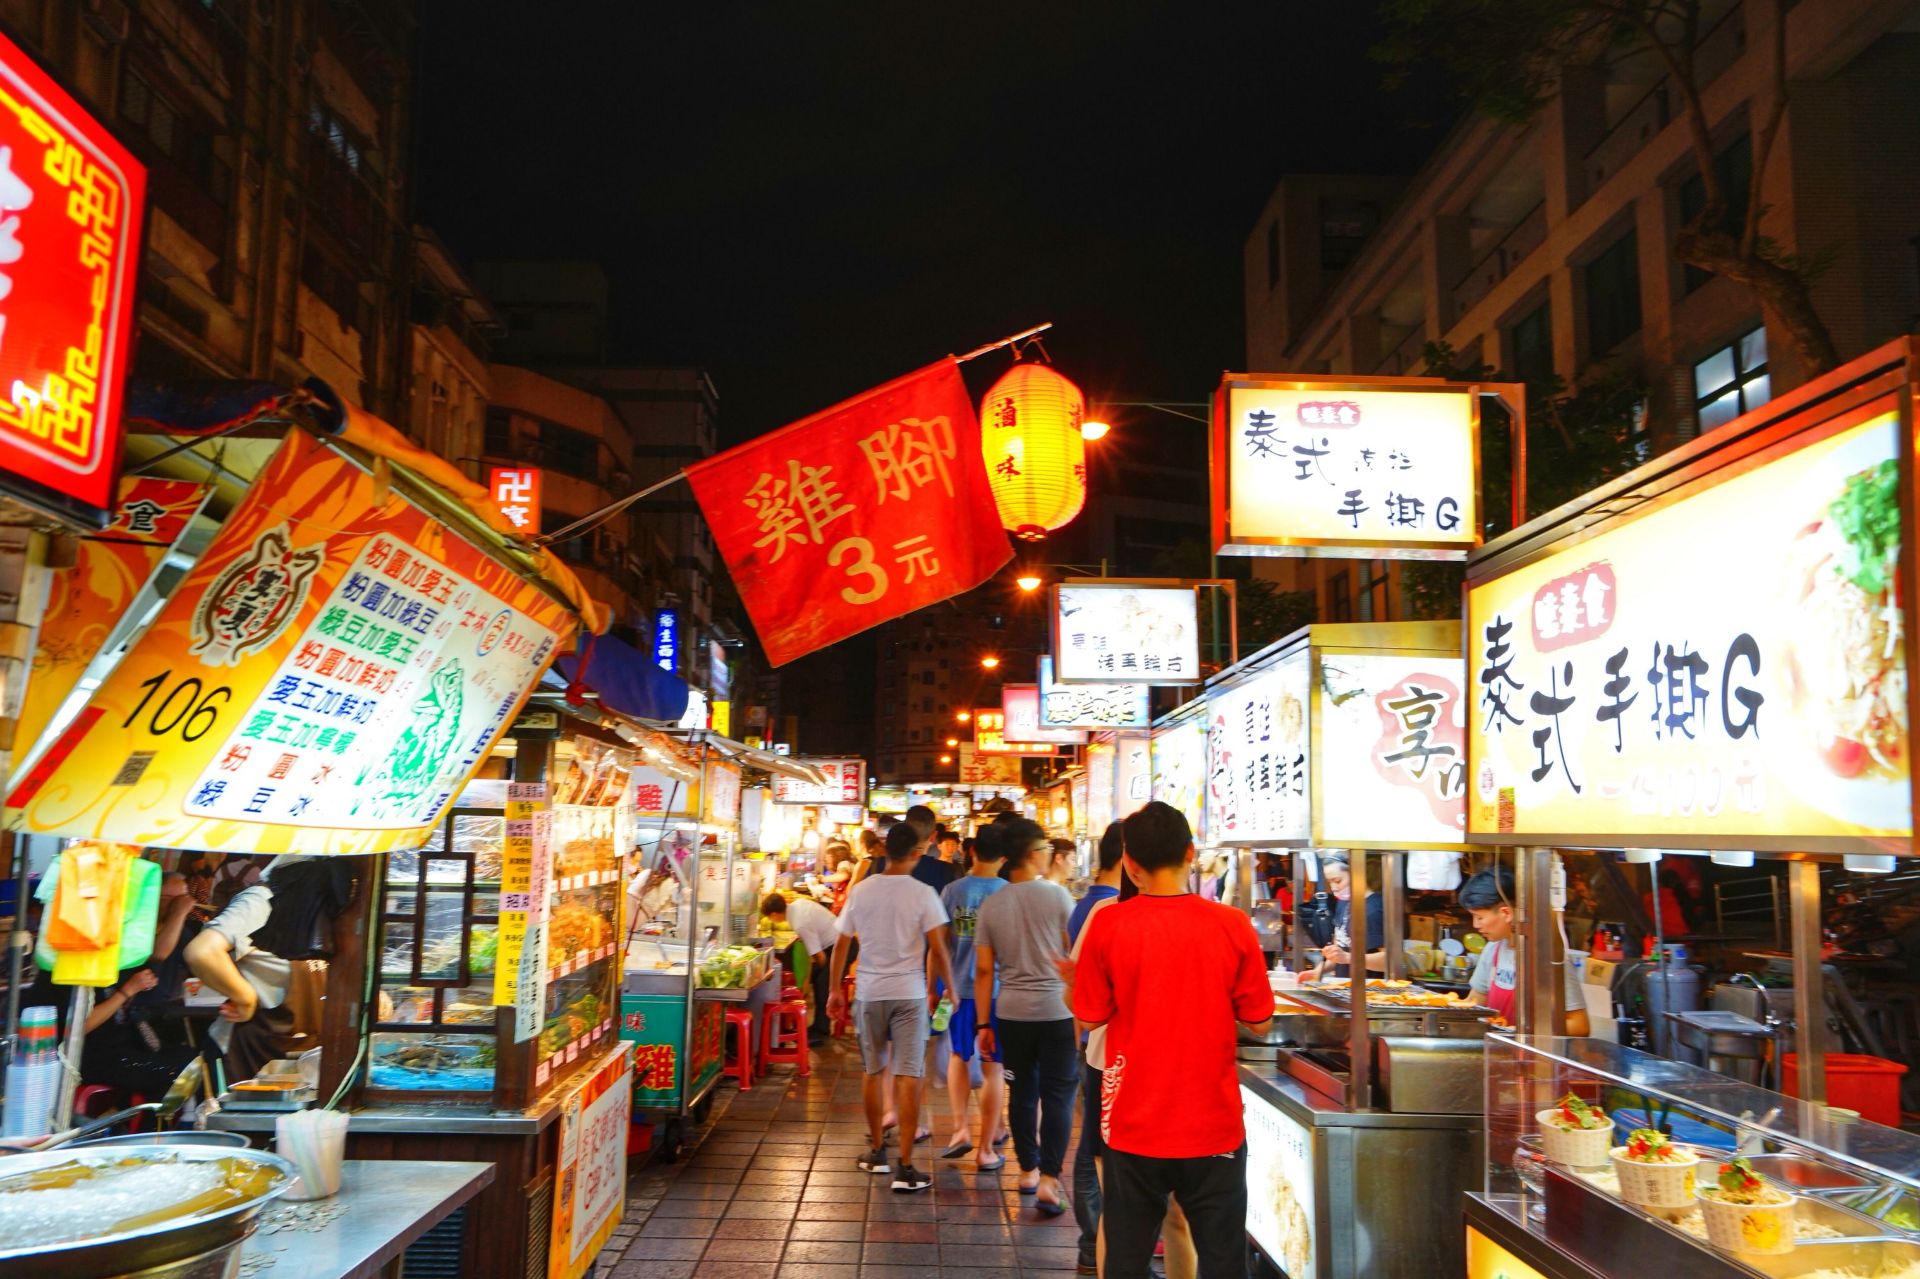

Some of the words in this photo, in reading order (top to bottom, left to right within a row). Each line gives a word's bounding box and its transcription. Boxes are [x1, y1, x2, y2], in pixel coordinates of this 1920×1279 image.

[1245, 409, 1336, 487] 泰式
[742, 415, 957, 565] 雞腳
[364, 537, 459, 605] 粉圓加愛玉
[826, 534, 941, 605] 3元
[316, 604, 420, 665] 綠豆加愛玉
[341, 571, 440, 635] 粉圓加綠豆
[267, 674, 378, 725] 愛玉加鮮奶
[293, 638, 400, 695] 粉圓加鮮奶
[121, 669, 232, 742] 106
[620, 1010, 647, 1032] 味
